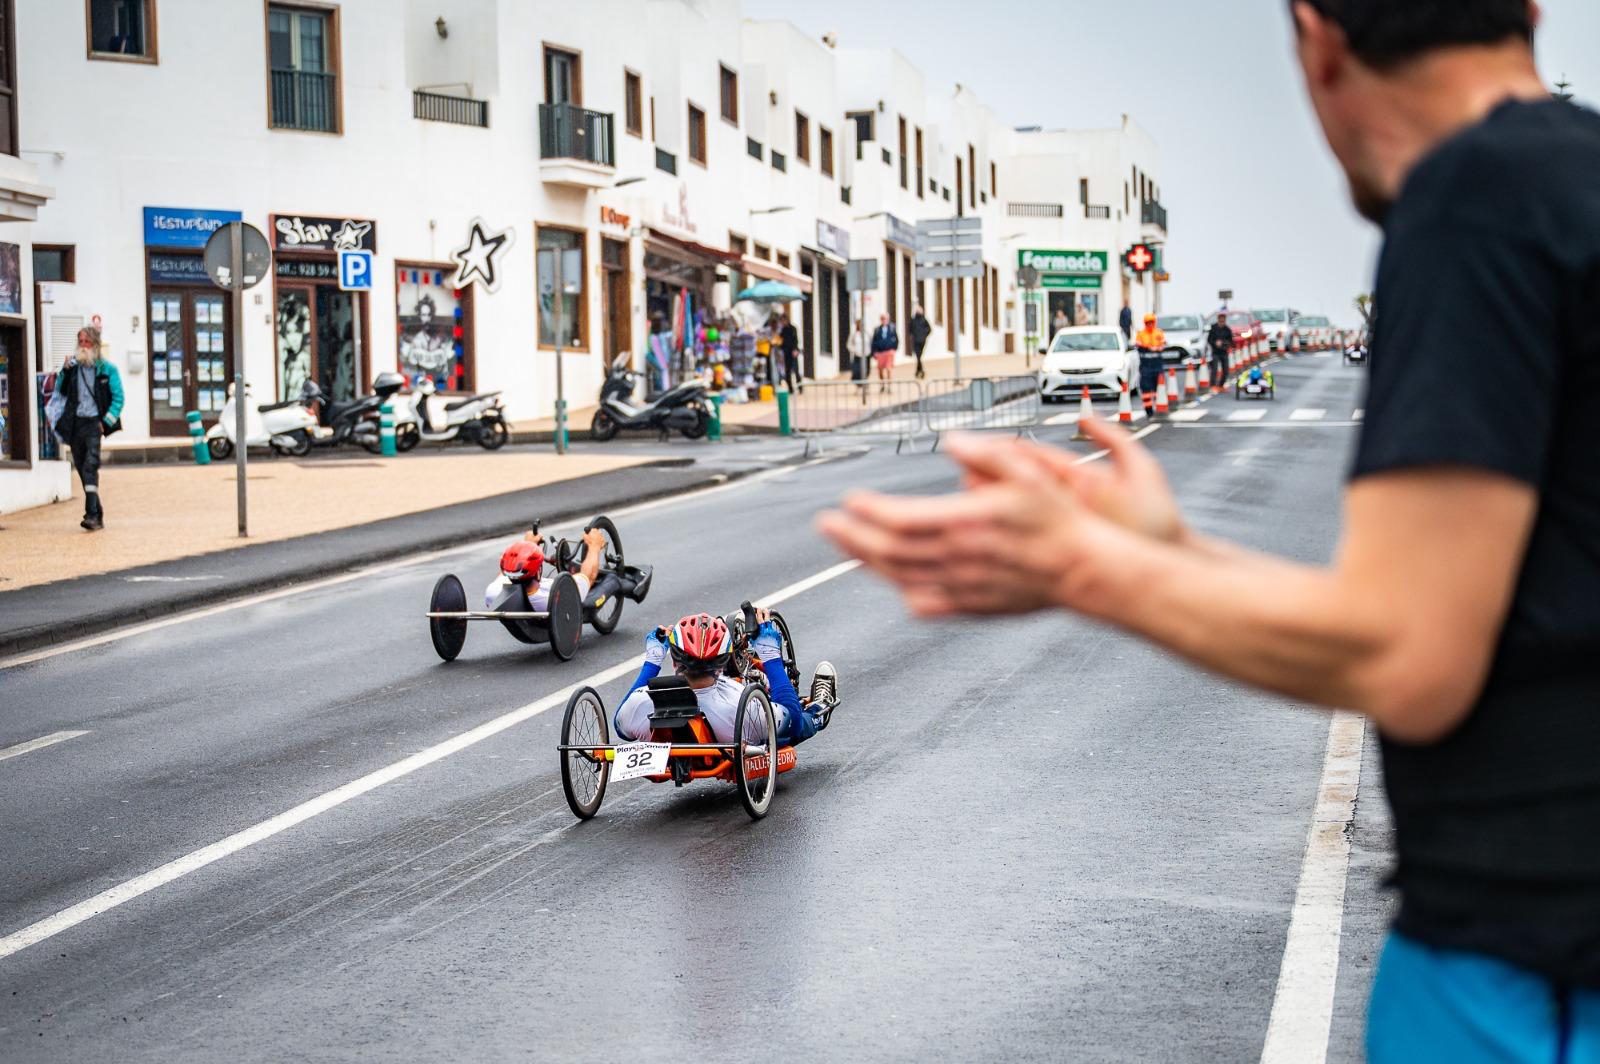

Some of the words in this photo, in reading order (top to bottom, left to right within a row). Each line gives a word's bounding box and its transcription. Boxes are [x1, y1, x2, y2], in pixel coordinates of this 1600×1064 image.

[276, 217, 332, 245] Star
[346, 255, 367, 286] P
[626, 751, 653, 769] 32
